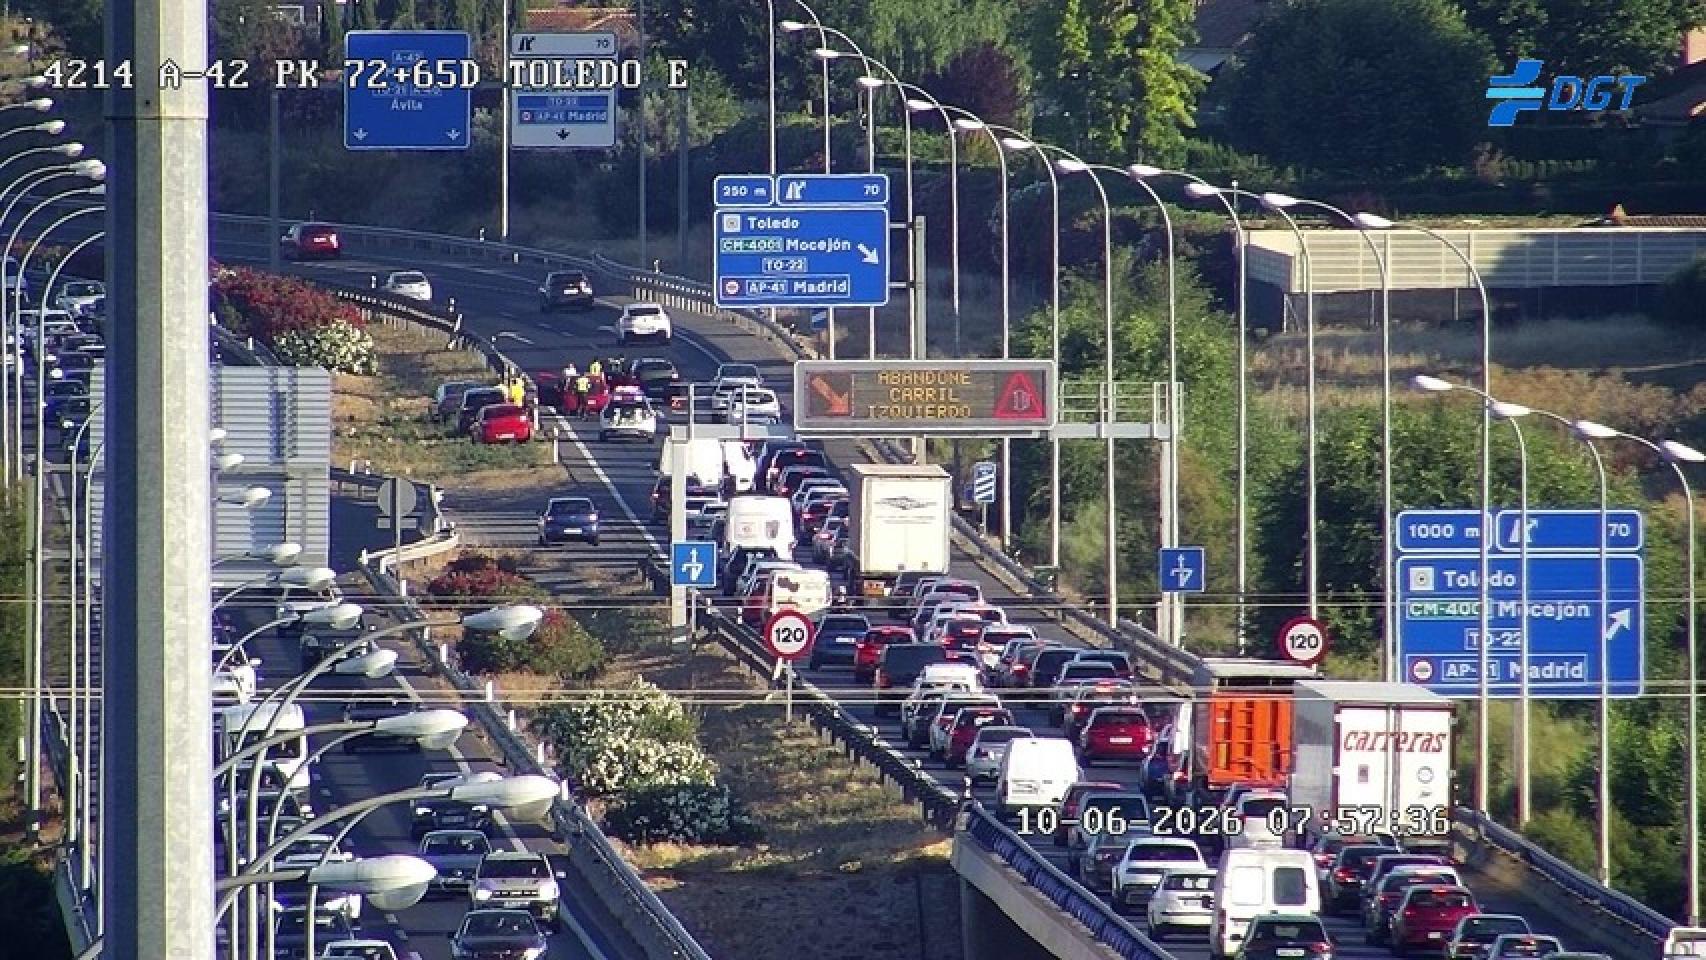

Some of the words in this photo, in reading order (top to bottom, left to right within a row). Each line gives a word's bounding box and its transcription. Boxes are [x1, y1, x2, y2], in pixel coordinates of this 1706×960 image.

[567, 111, 607, 120] Madrid
[722, 185, 748, 197] 250
[754, 187, 767, 196] m
[864, 184, 880, 196] 70
[748, 216, 799, 229] Toledo
[785, 237, 851, 253] Mocejón
[748, 283, 786, 294] AP-41
[793, 280, 847, 293] Madrid
[878, 371, 971, 385] ABANDONE
[889, 387, 960, 402] CARRIL
[868, 404, 971, 419] IZQUIERDO
[1408, 523, 1454, 538] 1000
[1464, 527, 1480, 538] m
[1608, 523, 1630, 536] 70
[1442, 570, 1516, 587] Toldo
[775, 627, 805, 642] 120
[1289, 633, 1319, 649] 120
[1446, 662, 1497, 677] AP-1
[1343, 729, 1447, 753] carreras
